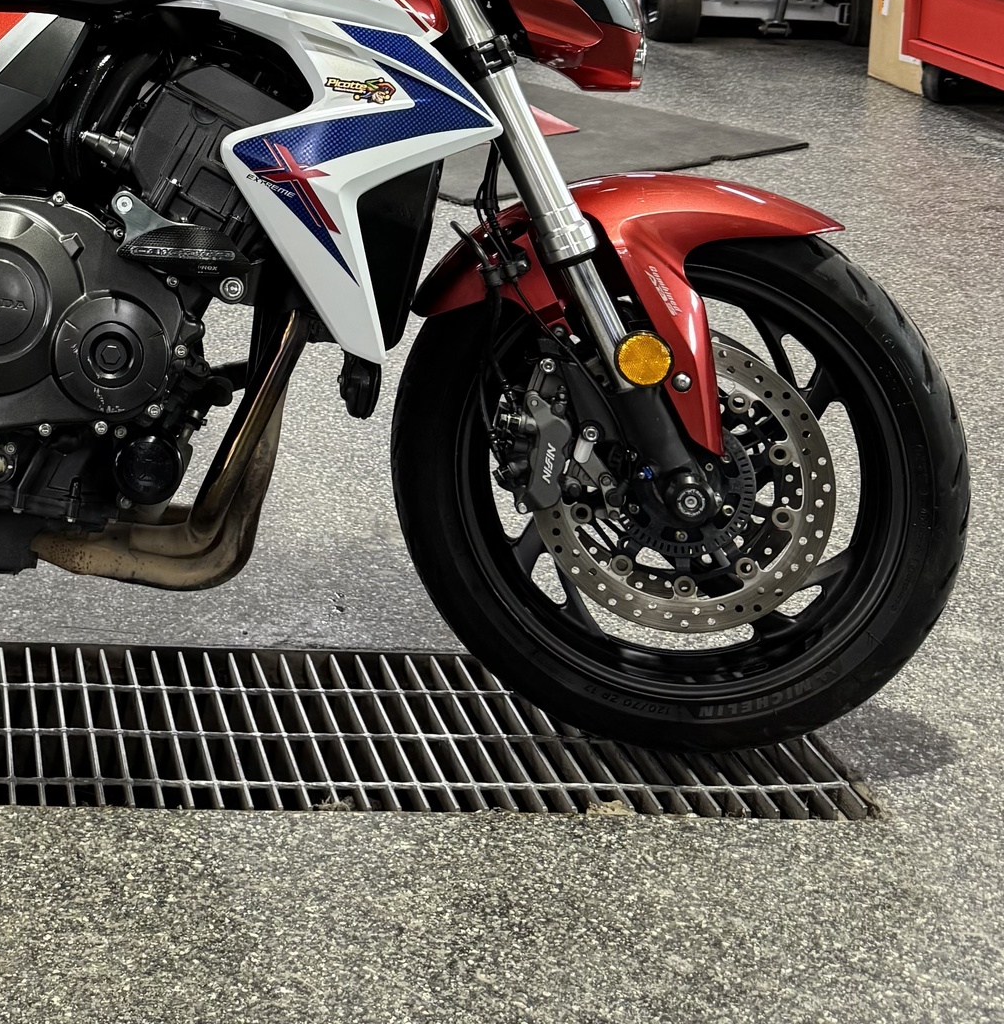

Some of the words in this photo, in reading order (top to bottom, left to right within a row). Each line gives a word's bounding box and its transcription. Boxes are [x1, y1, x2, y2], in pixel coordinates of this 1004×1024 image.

[326, 78, 368, 92] Picotte
[246, 173, 297, 199] EXTREME
[541, 442, 557, 484] NISSIN
[698, 681, 812, 718] MICHELIN
